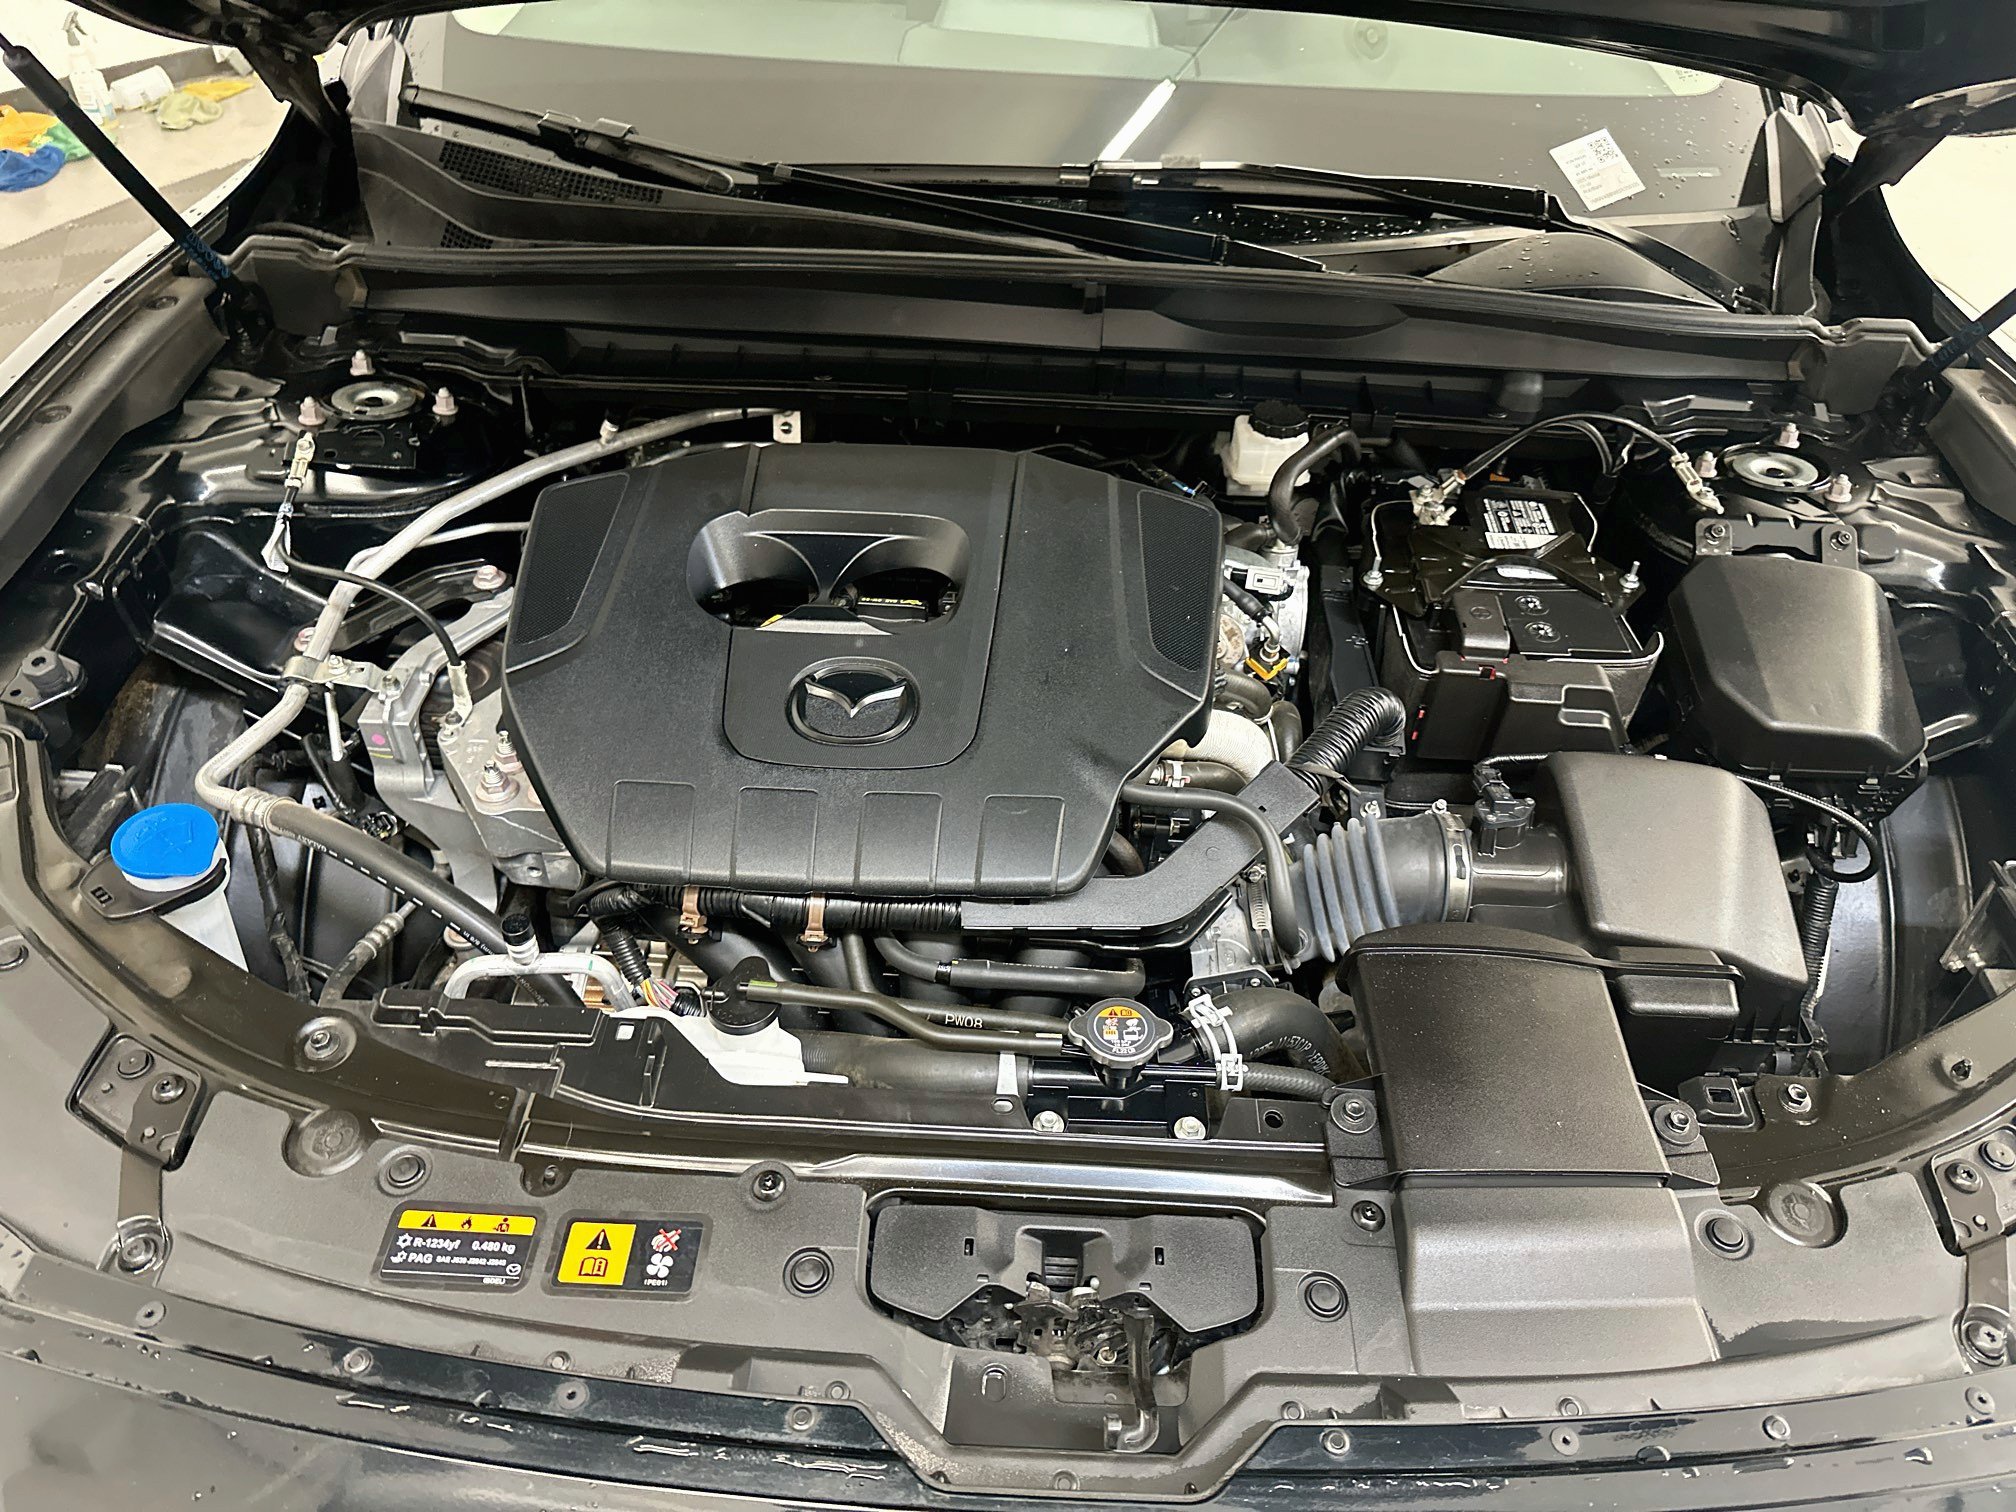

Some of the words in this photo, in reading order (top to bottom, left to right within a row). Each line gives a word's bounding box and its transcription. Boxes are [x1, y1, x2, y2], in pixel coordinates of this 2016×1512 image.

[413, 1237, 461, 1251] R-1234yf
[472, 1240, 500, 1252] 0.480
[501, 1242, 516, 1254] kg
[408, 1252, 433, 1264] PAG
